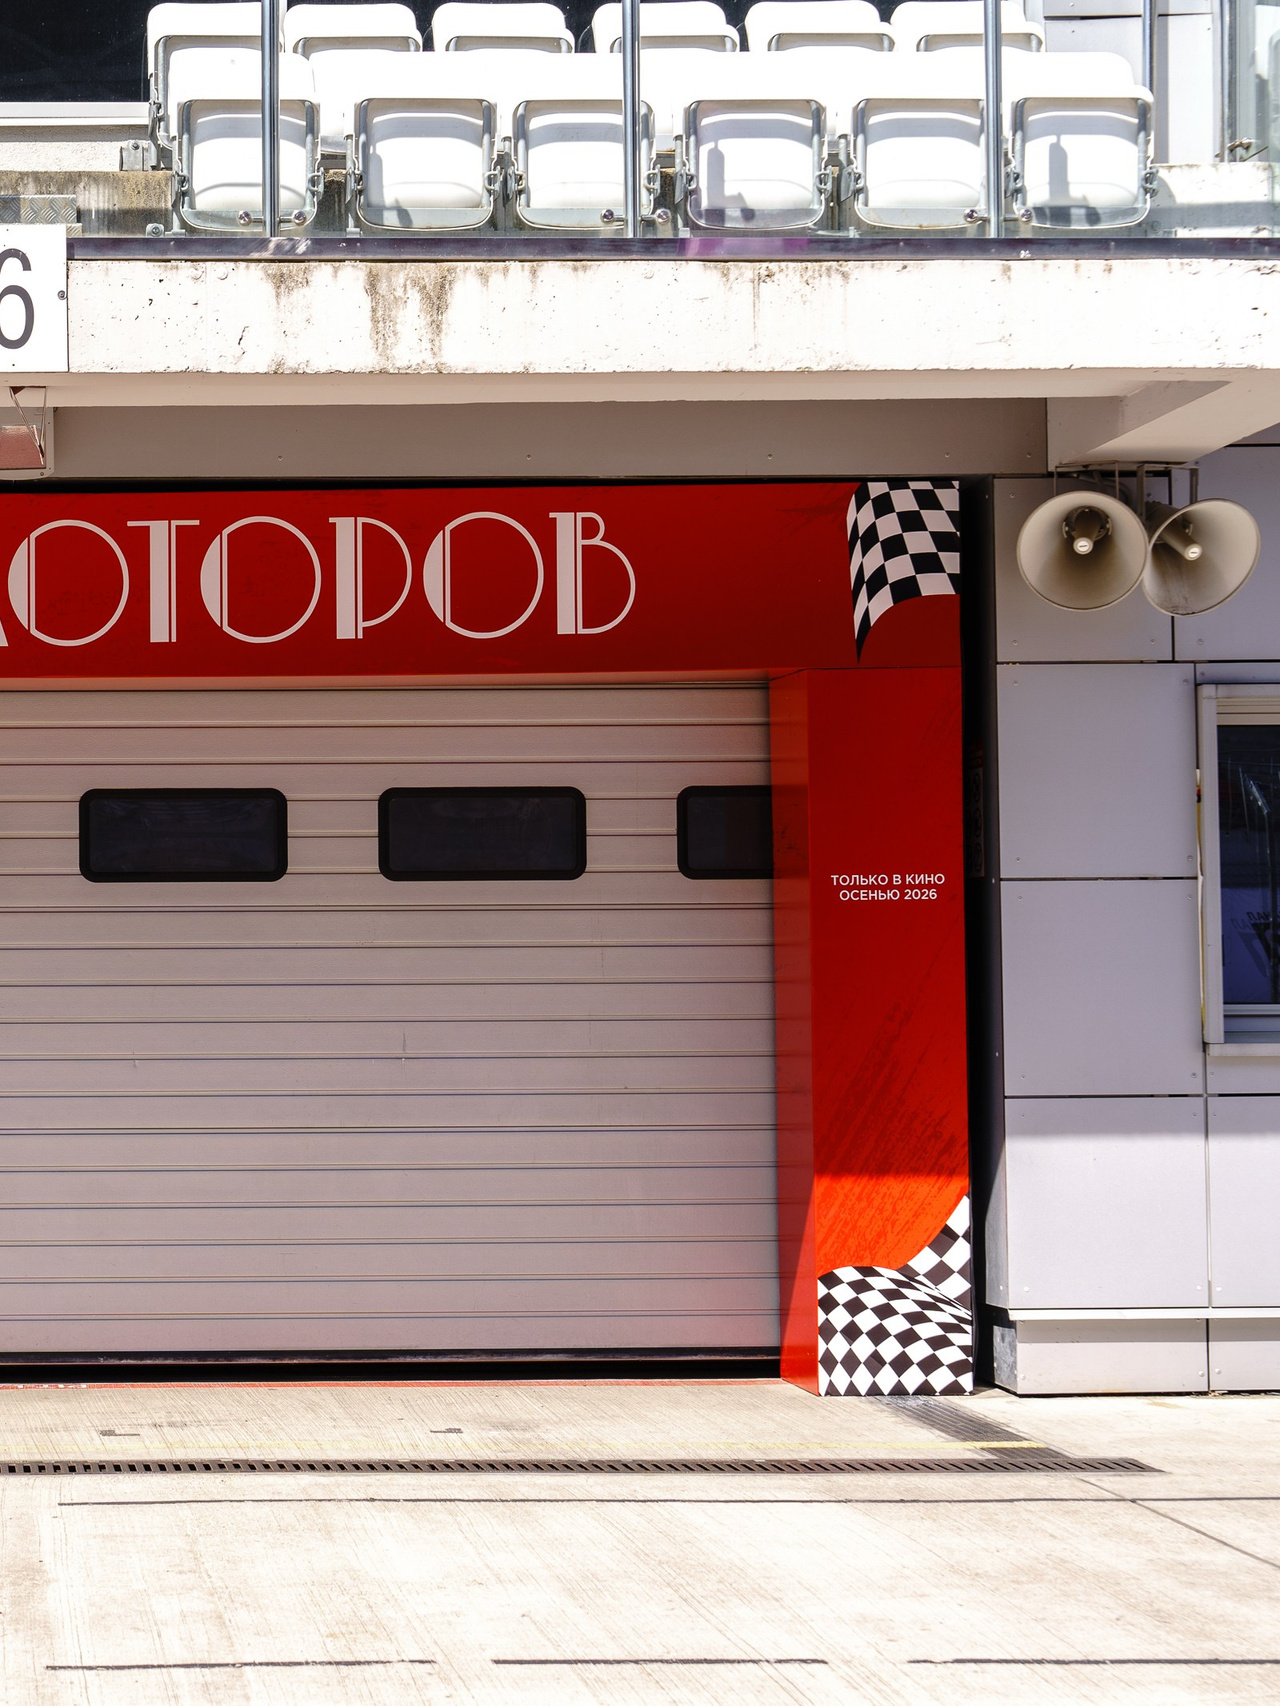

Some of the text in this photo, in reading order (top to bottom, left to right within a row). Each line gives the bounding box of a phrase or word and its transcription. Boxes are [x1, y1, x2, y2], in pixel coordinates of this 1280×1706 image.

[830, 873, 946, 886] ТОЛЬКО В КИНО
[839, 888, 938, 901] ОСЕНЬЮ 2026
